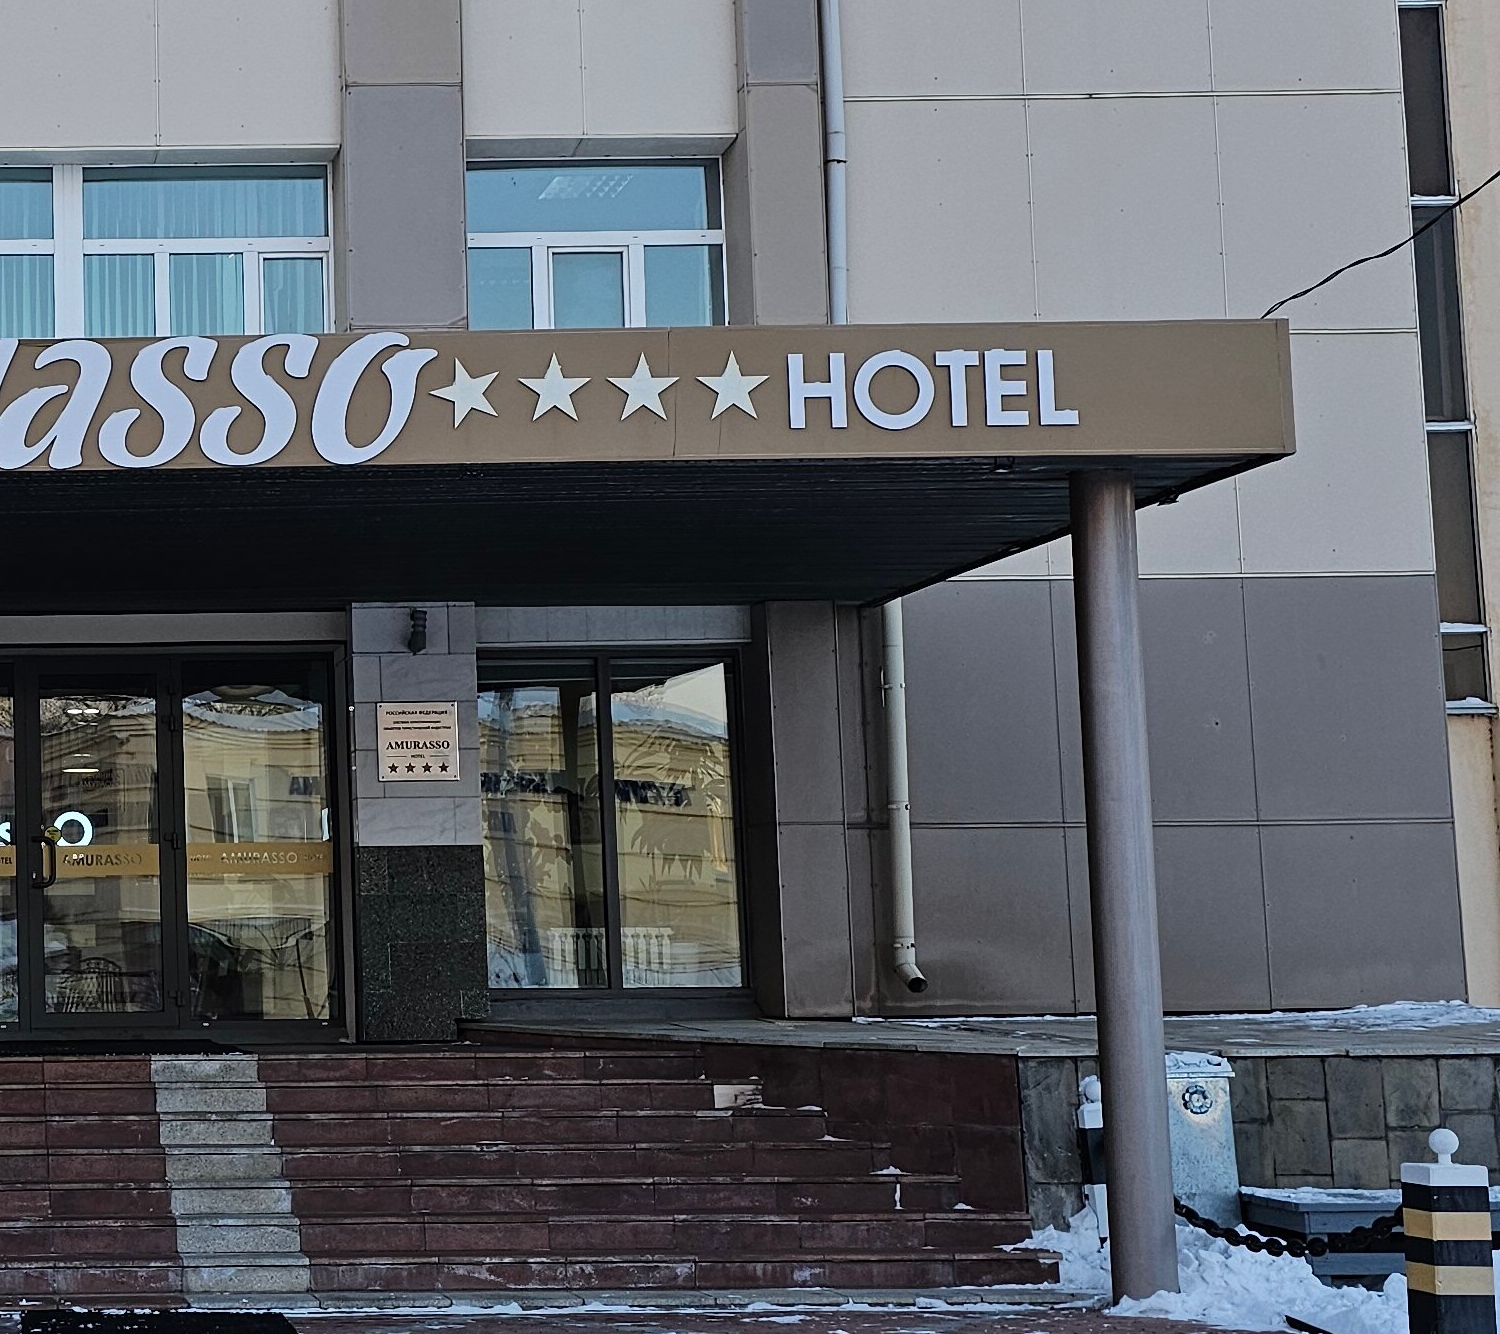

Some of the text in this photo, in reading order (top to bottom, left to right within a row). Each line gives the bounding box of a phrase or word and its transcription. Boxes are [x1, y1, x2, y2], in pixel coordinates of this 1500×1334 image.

[786, 347, 1081, 430] HOTEL
[386, 740, 450, 750] AMURASSO
[63, 853, 143, 867] AMURASSO
